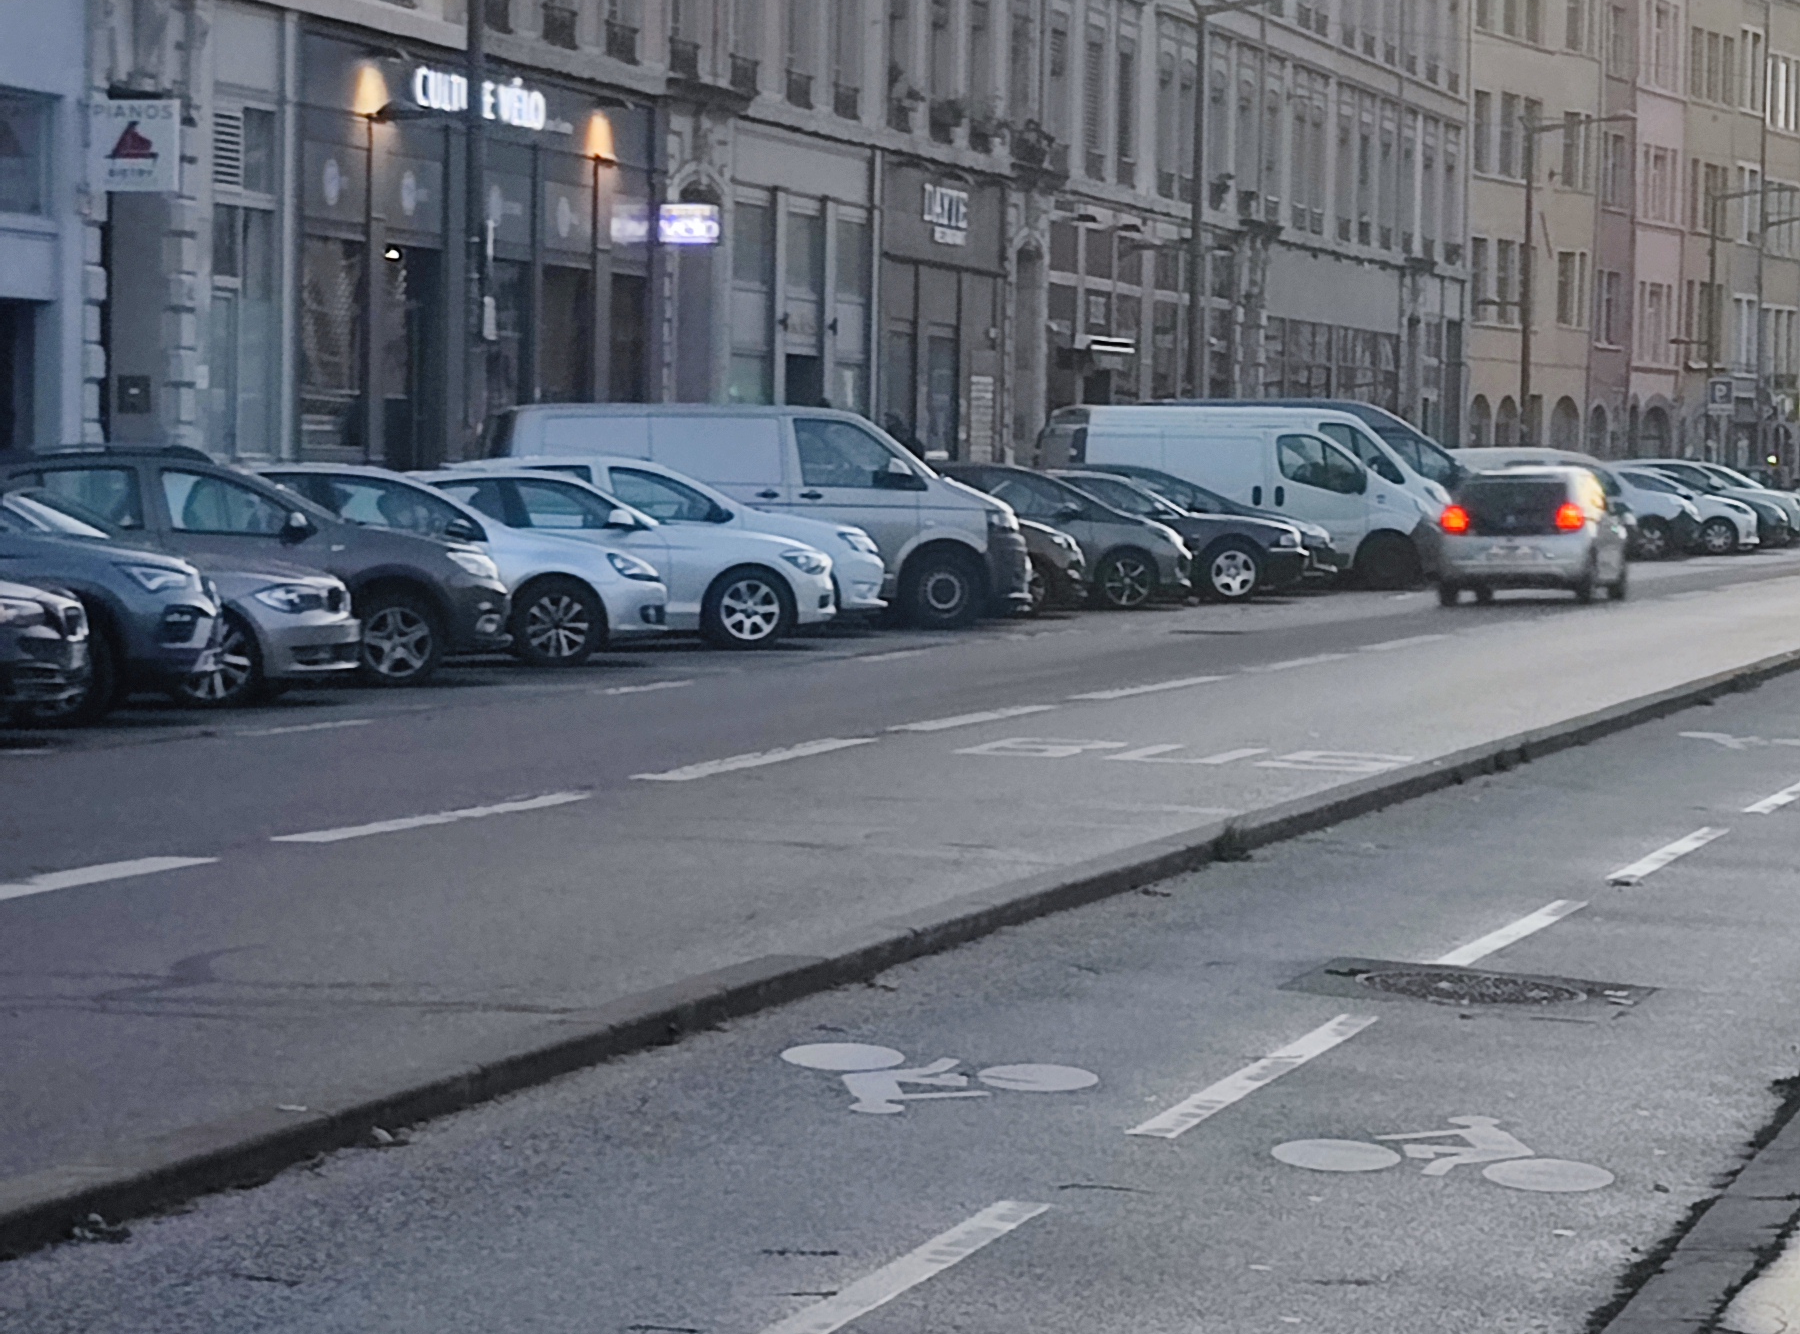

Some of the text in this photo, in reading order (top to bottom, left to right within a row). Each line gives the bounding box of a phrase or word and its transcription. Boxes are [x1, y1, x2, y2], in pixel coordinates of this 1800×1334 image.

[93, 104, 174, 120] PIANOS
[497, 76, 547, 131] VÉLO
[953, 736, 1416, 773] BUS
